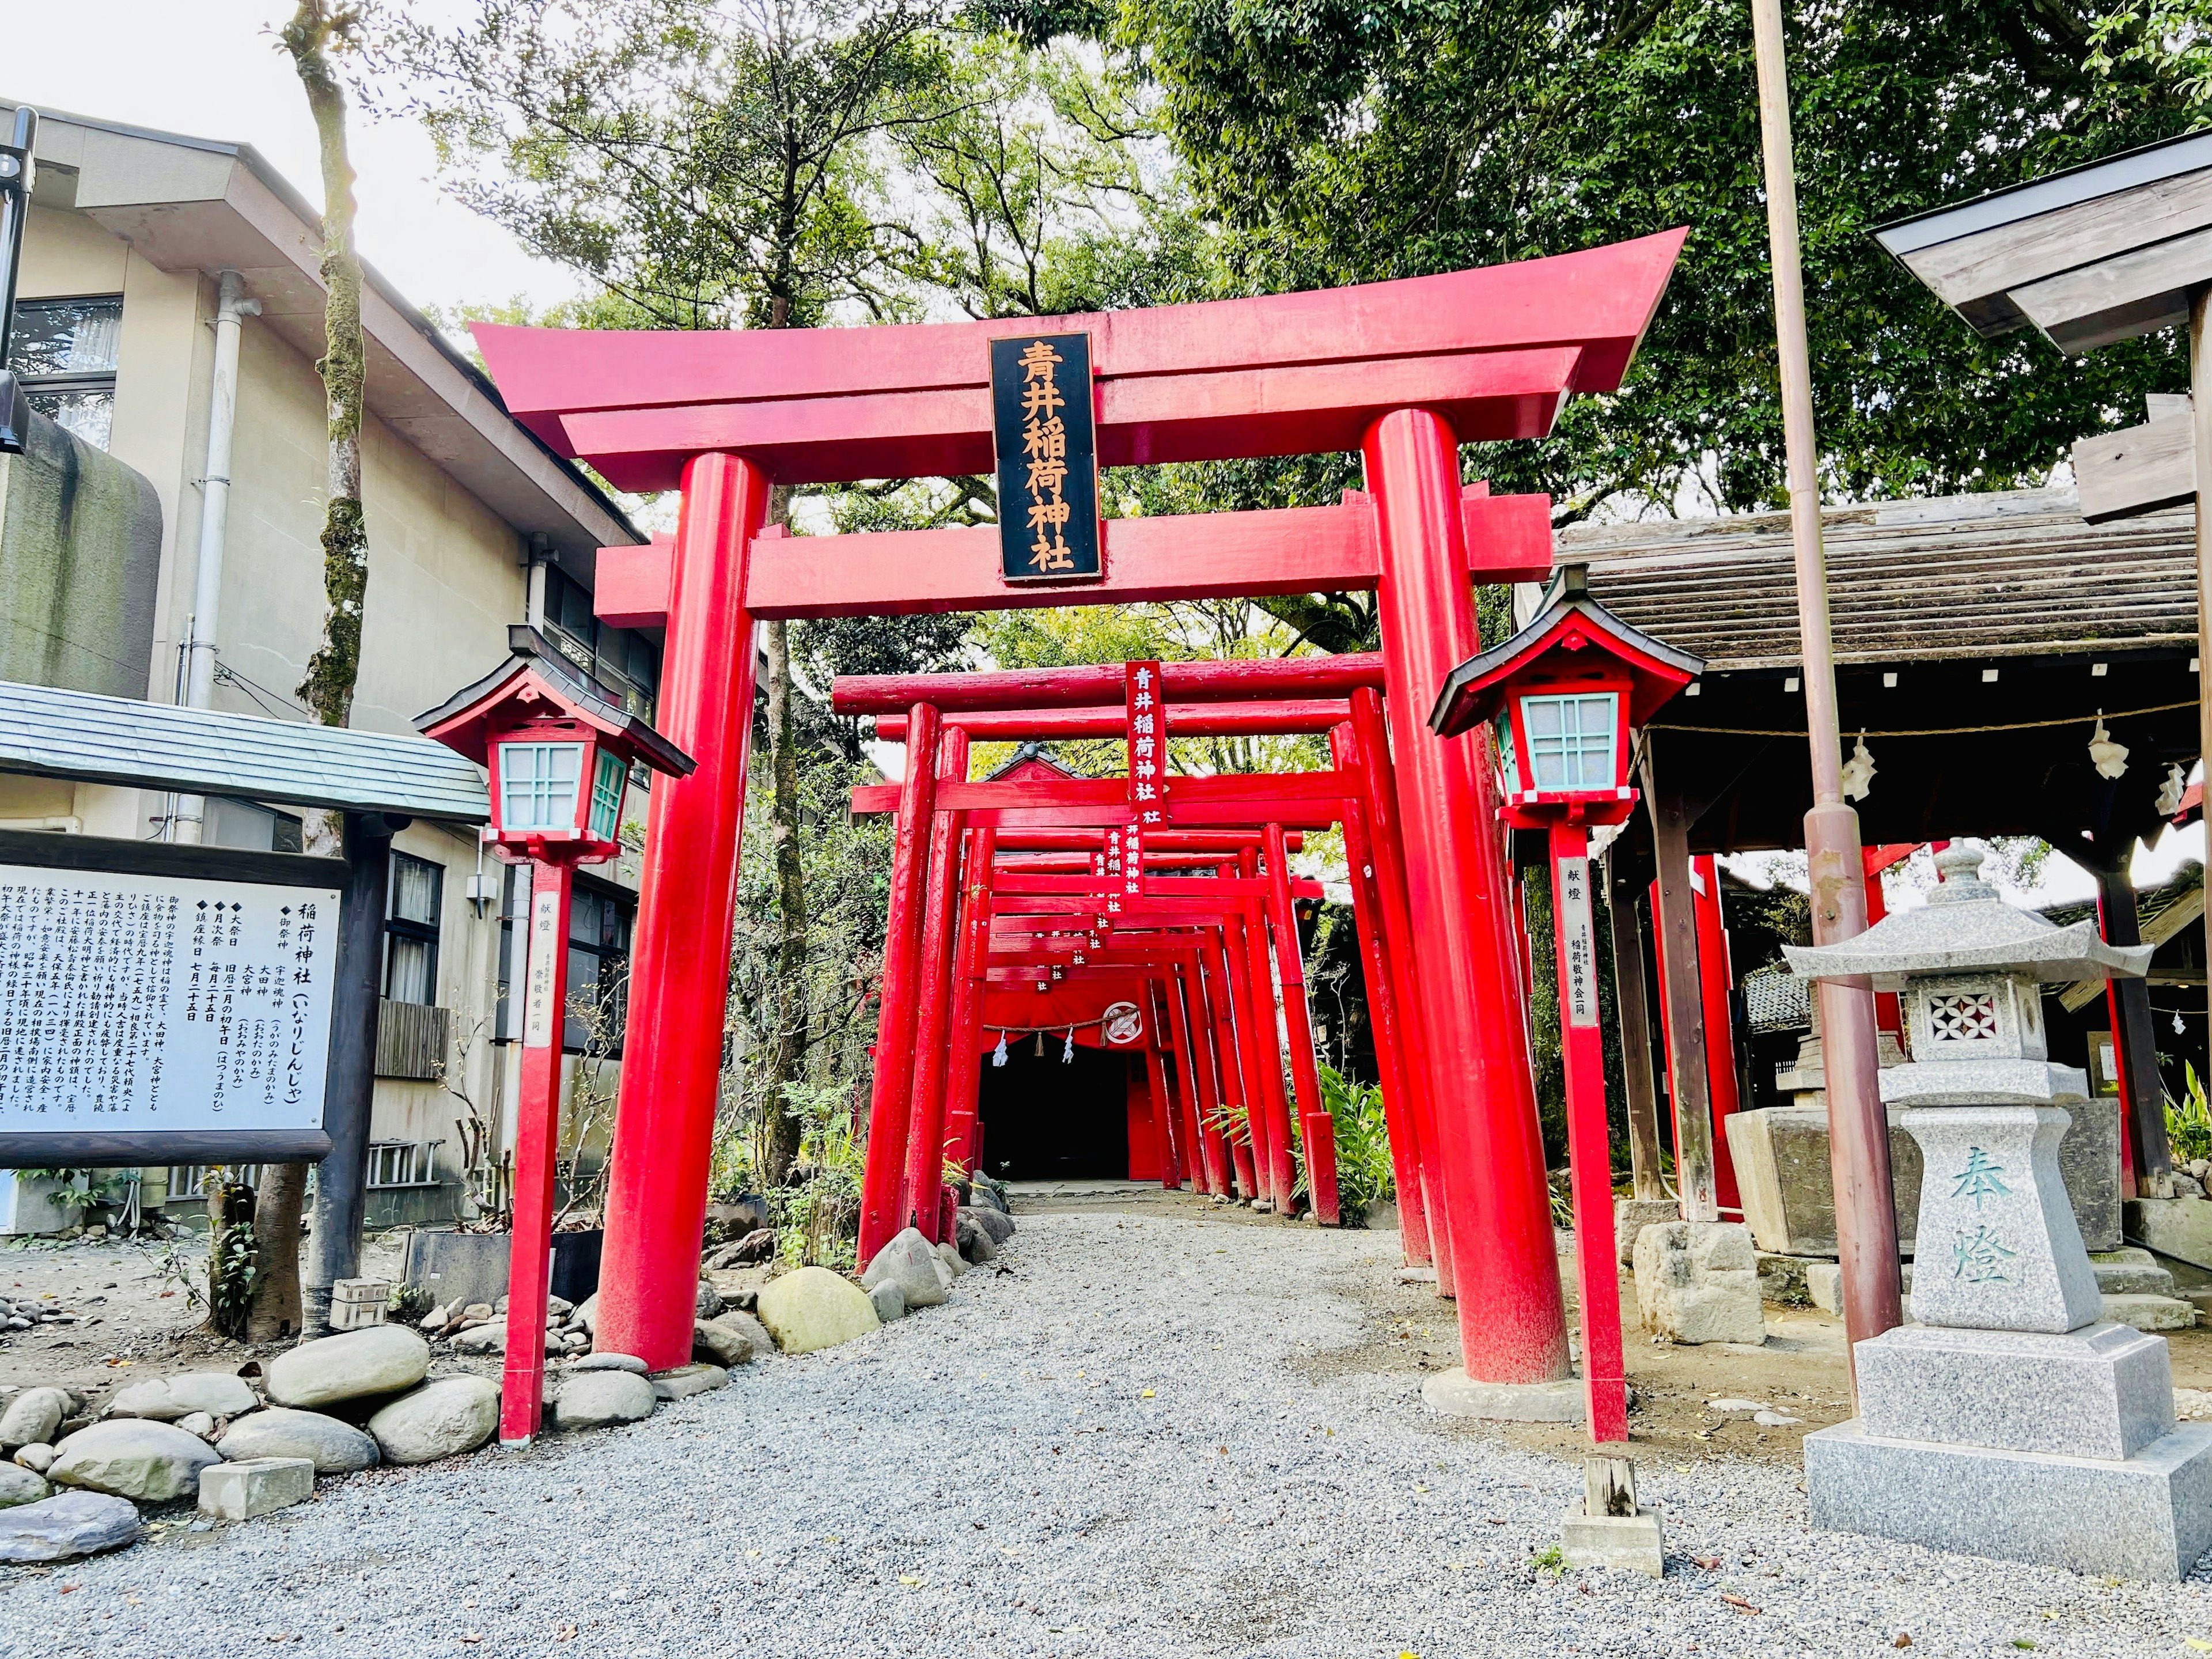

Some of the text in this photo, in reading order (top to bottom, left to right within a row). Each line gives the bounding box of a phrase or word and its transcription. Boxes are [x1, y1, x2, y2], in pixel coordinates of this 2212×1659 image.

[1018, 340, 1075, 573] 青井稲荷神社
[1133, 666, 1157, 802] 青井稲荷神社
[1568, 869, 1581, 900] 献燈
[229, 914, 242, 946] 大祭日
[204, 914, 224, 1022] 月次祭 毎月二十五日
[240, 964, 255, 996] 大宮神
[257, 965, 271, 997] 大田神
[1571, 940, 1585, 1015] 稲荷敬神会一同
[1949, 1146, 2017, 1283] 奉燈
